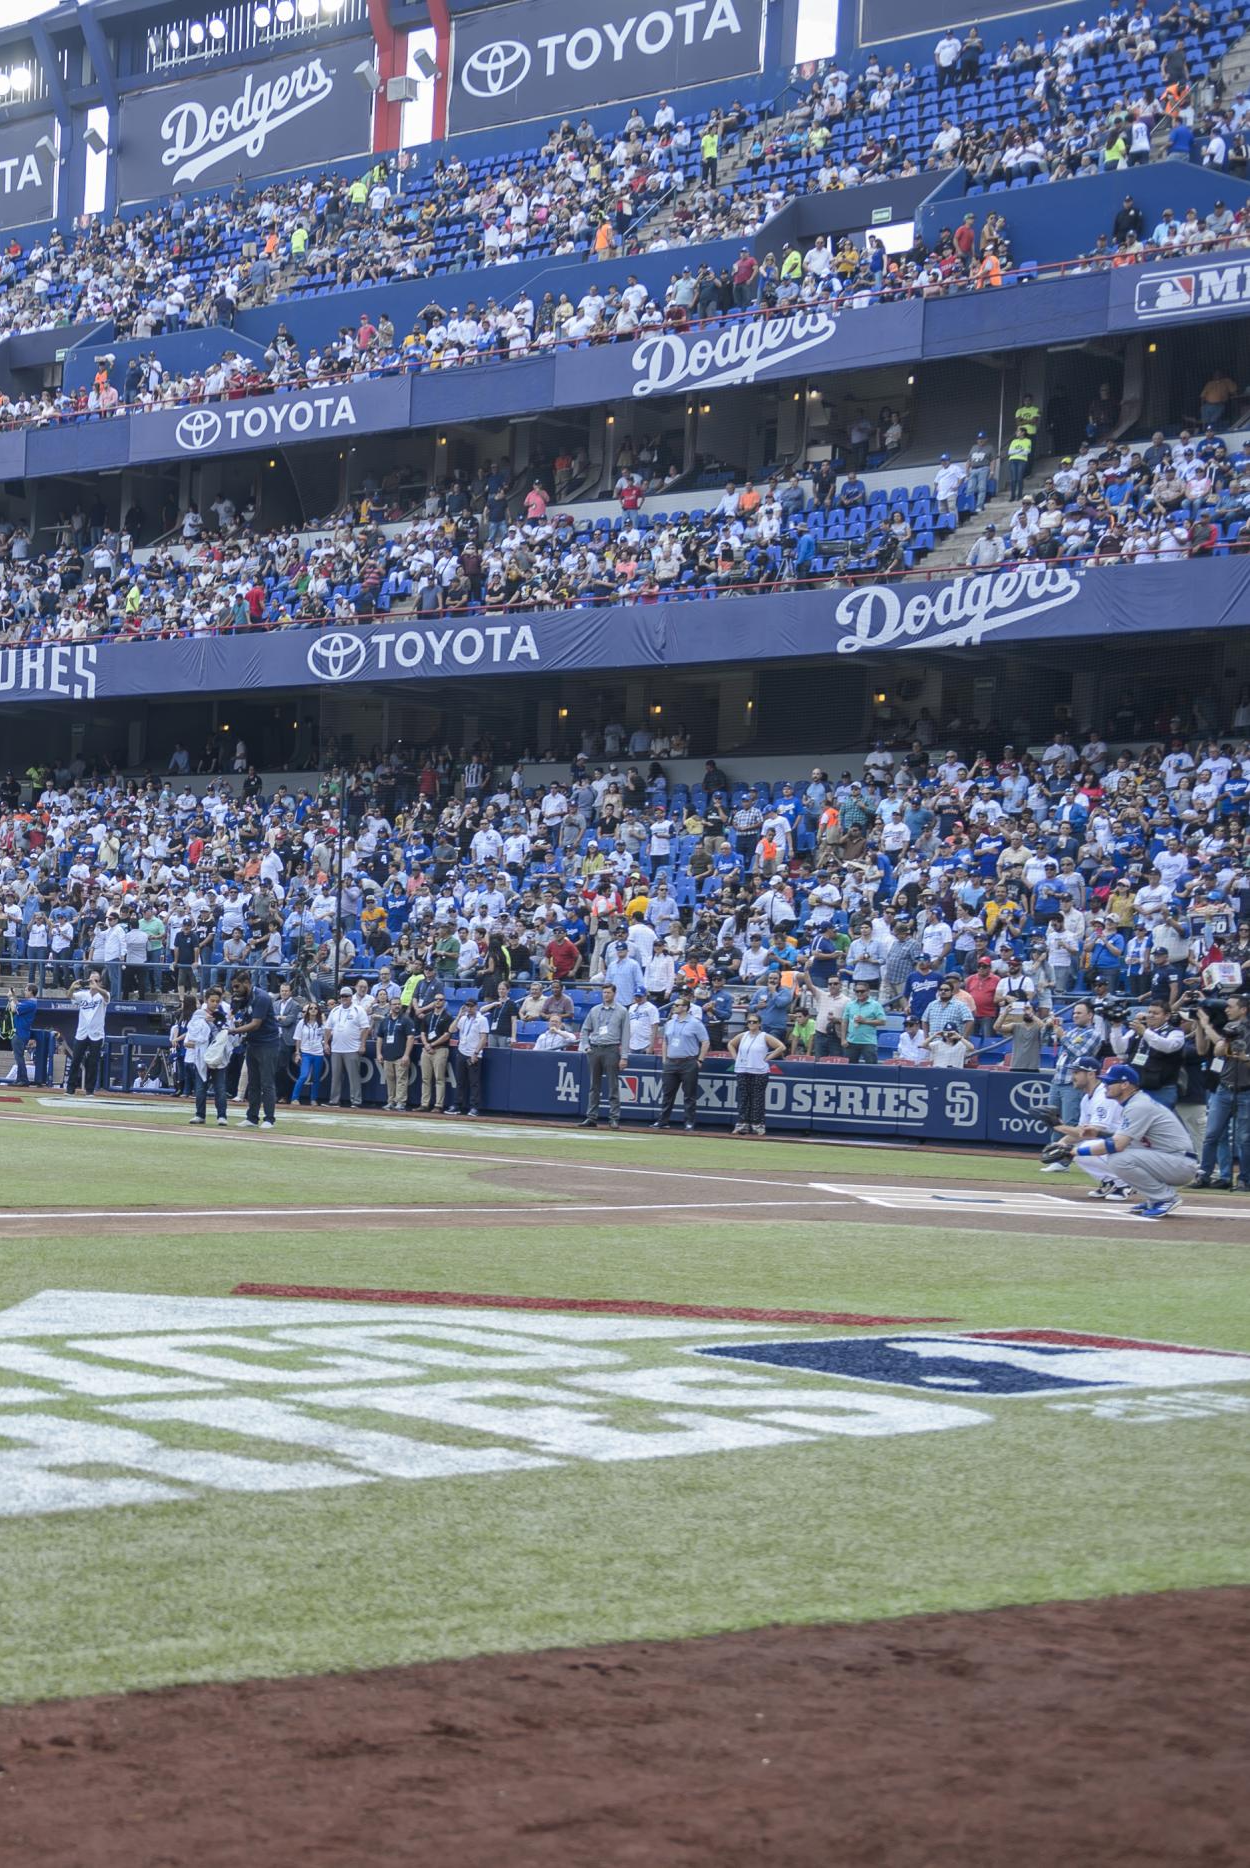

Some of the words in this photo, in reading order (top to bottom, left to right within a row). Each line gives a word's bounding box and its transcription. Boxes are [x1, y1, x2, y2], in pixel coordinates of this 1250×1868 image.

[538, 0, 741, 77] TOYOTA
[161, 58, 333, 185] Dodgers
[632, 310, 836, 397] Dodgers
[226, 396, 356, 439] TOYOTA
[835, 568, 1081, 653] Dodgers
[371, 625, 540, 669] TOYOTA
[556, 1062, 580, 1102] LA
[640, 1076, 787, 1111] MXIO
[791, 1082, 929, 1120] SERIES
